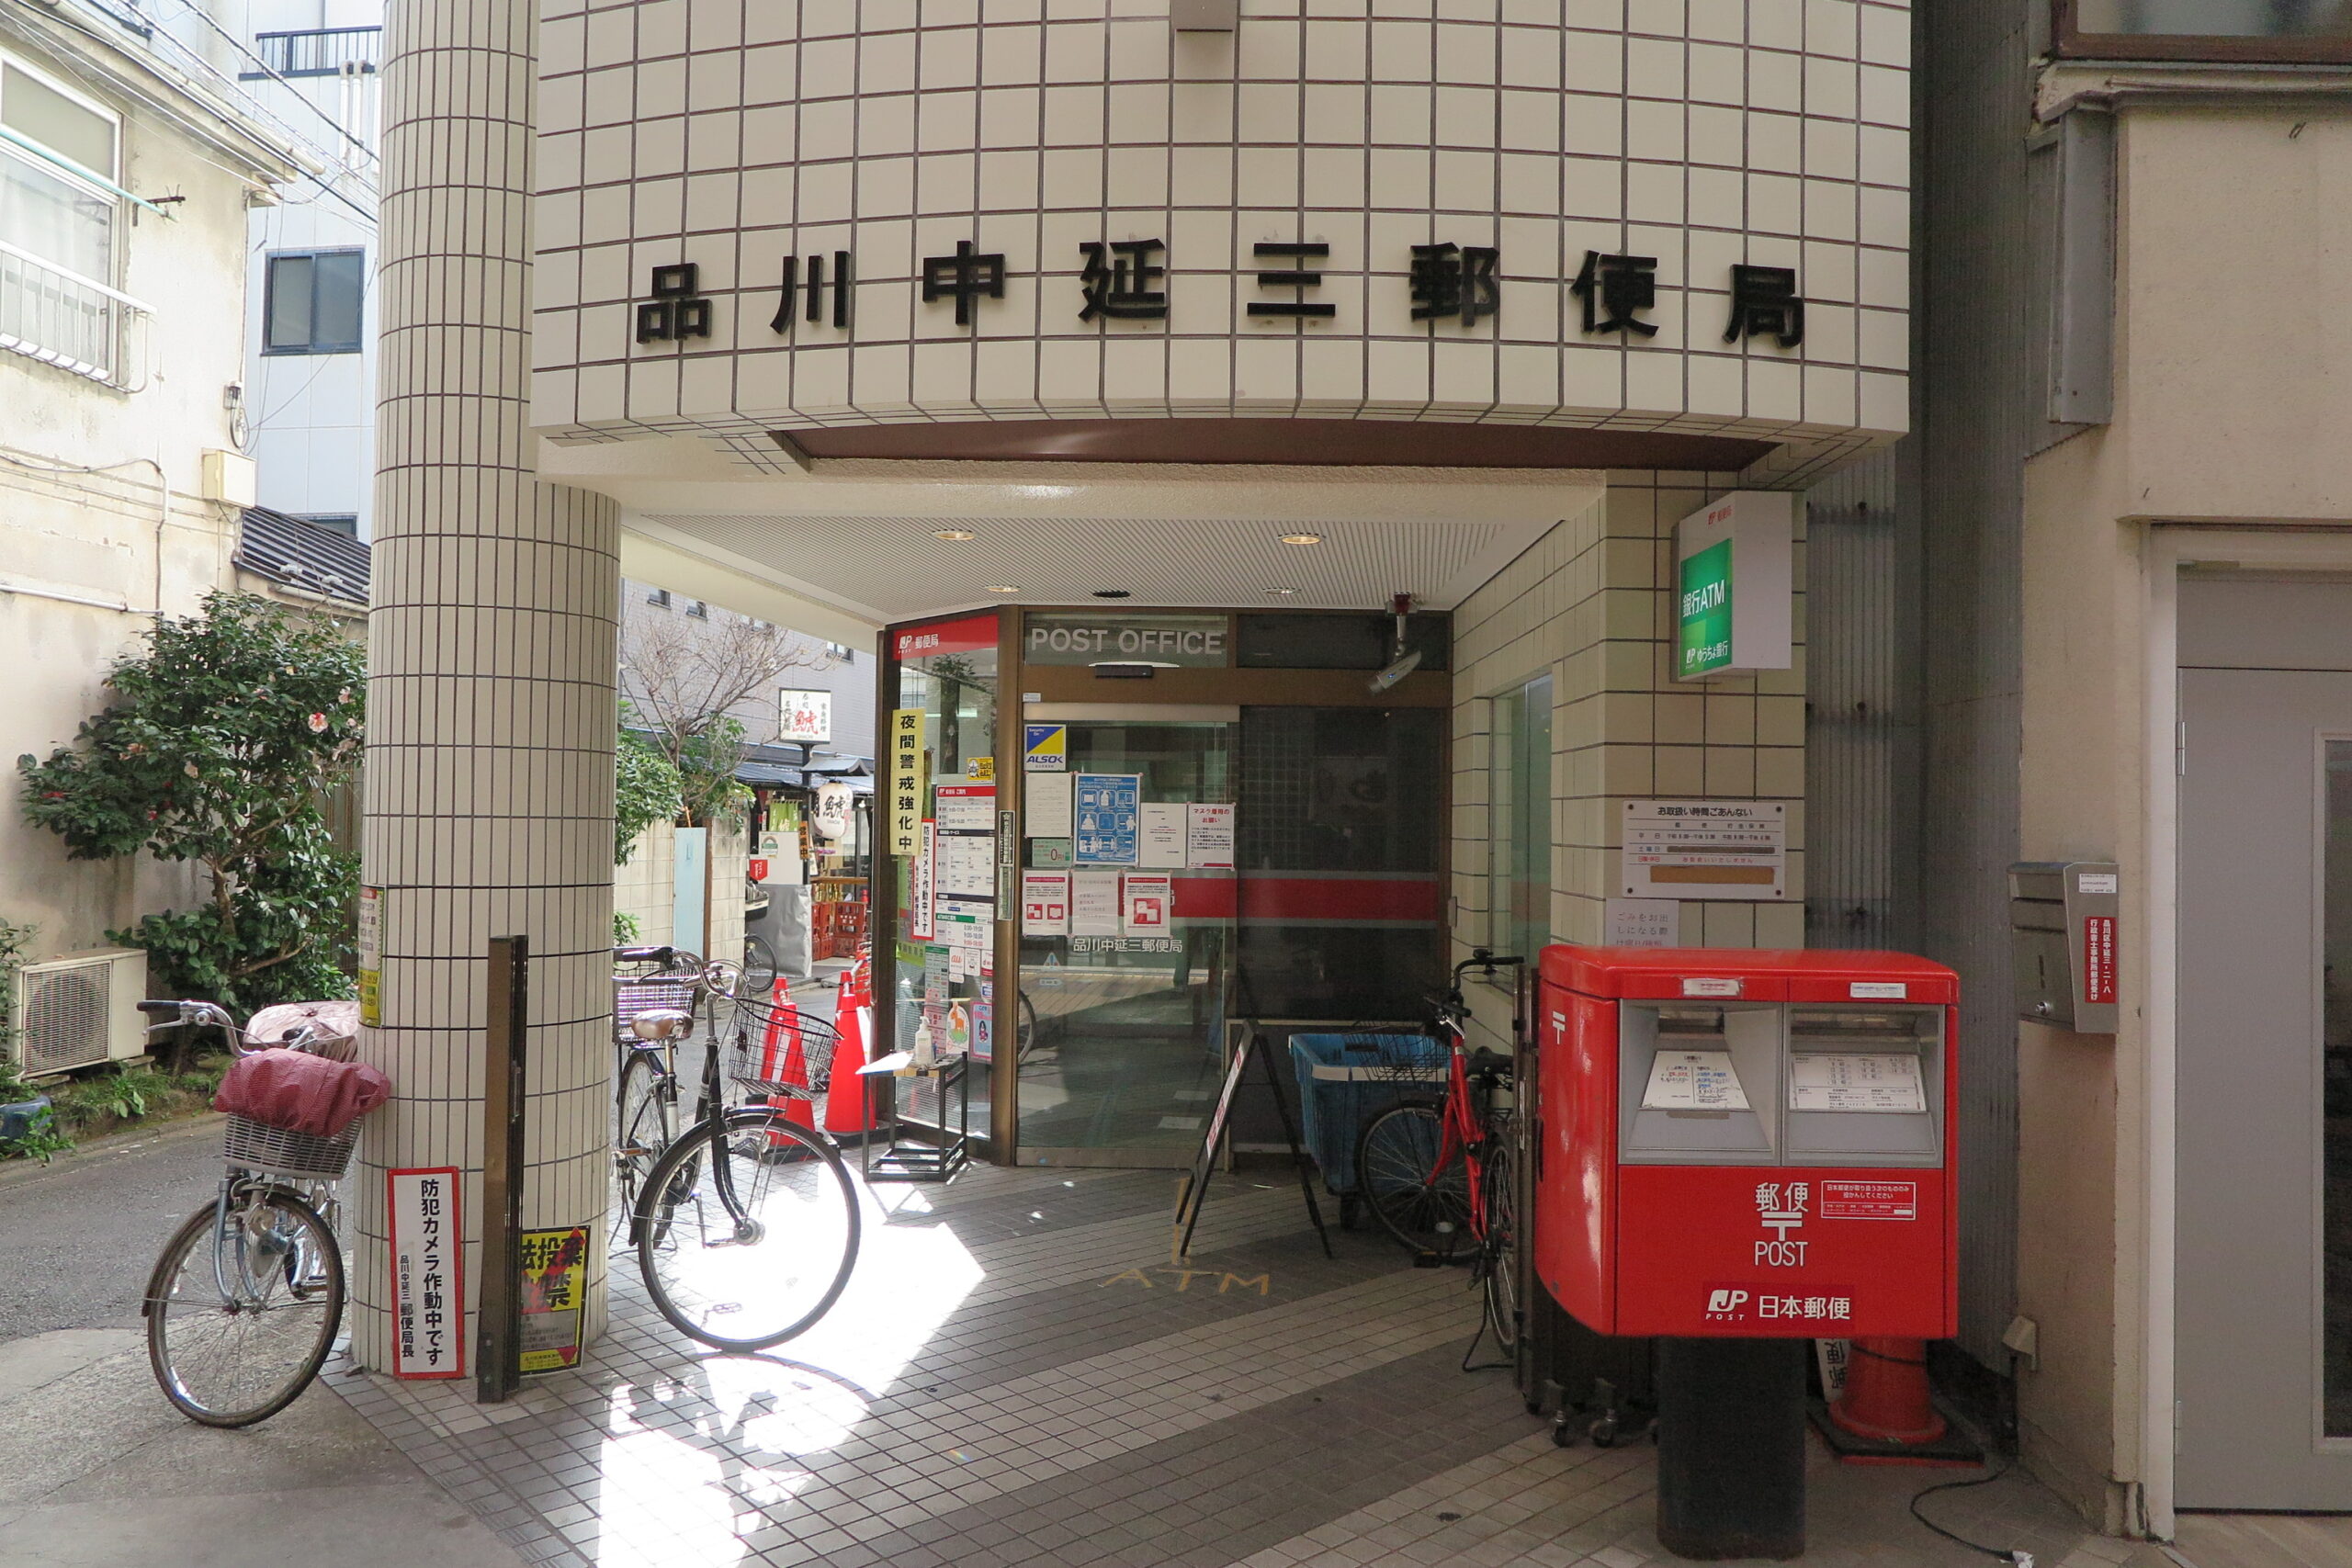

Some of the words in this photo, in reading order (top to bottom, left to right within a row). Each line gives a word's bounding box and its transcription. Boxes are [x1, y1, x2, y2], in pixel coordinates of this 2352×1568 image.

[635, 236, 1806, 351] 品川中延三郵便局
[1682, 579, 1725, 618] 銀行ATM
[915, 633, 939, 649] 郵便局
[1030, 627, 1102, 653] POST
[1117, 629, 1225, 656] OFFICE
[1696, 639, 1729, 664] ゆうちょ銀行
[1026, 755, 1064, 764] ALSOK
[898, 714, 917, 852] 夜間警戒強化中
[1657, 806, 1753, 818] お取扱い時間ごあんない
[922, 825, 931, 933] 防犯カメラ作動中です
[1616, 912, 1669, 923] ごみをお出
[1072, 938, 1183, 953] 品川中延三郵便局
[1755, 1181, 1810, 1213] 郵便
[1754, 1241, 1809, 1267] POST
[420, 1179, 445, 1366] 防犯カメラ作動中です
[1099, 1268, 1272, 1296] ATM
[399, 1255, 415, 1359] 品川中延三郵便局長
[1705, 1313, 1745, 1321] POST
[1758, 1295, 1851, 1320] 日本郵便
